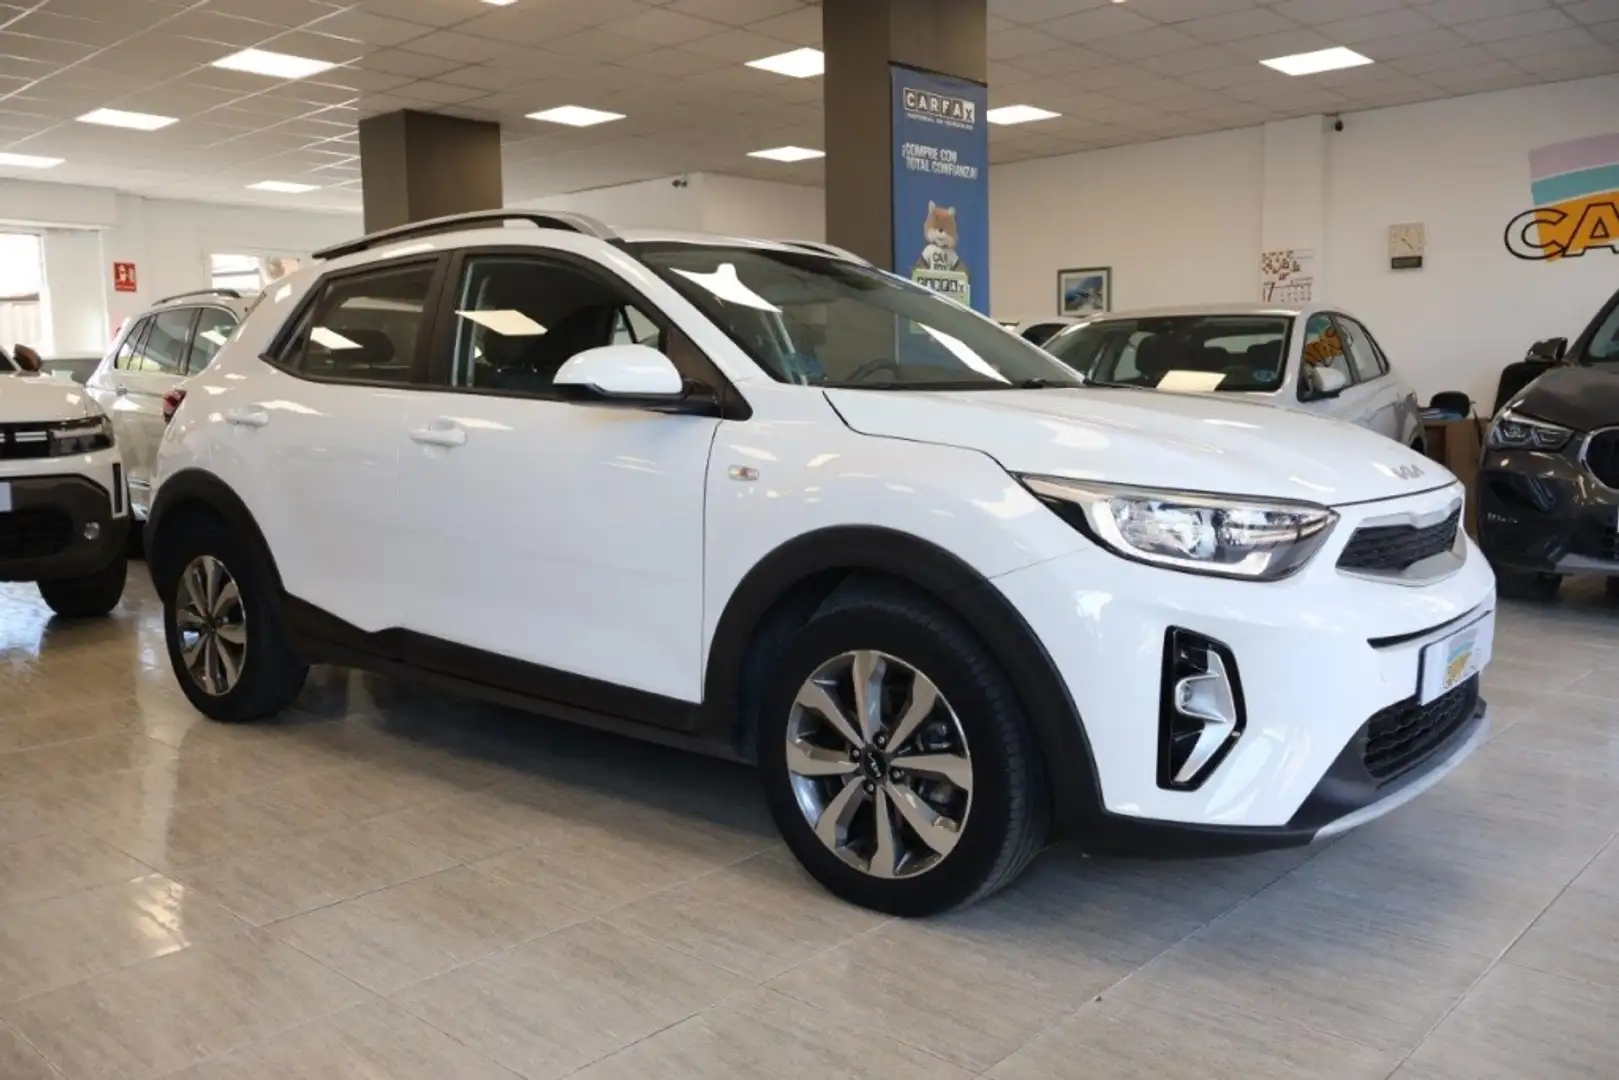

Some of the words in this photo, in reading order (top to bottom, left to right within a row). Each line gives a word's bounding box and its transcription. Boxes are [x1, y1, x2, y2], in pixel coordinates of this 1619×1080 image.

[906, 91, 974, 122] CARFAX
[906, 156, 930, 173] TOTAL
[940, 148, 958, 164] CON
